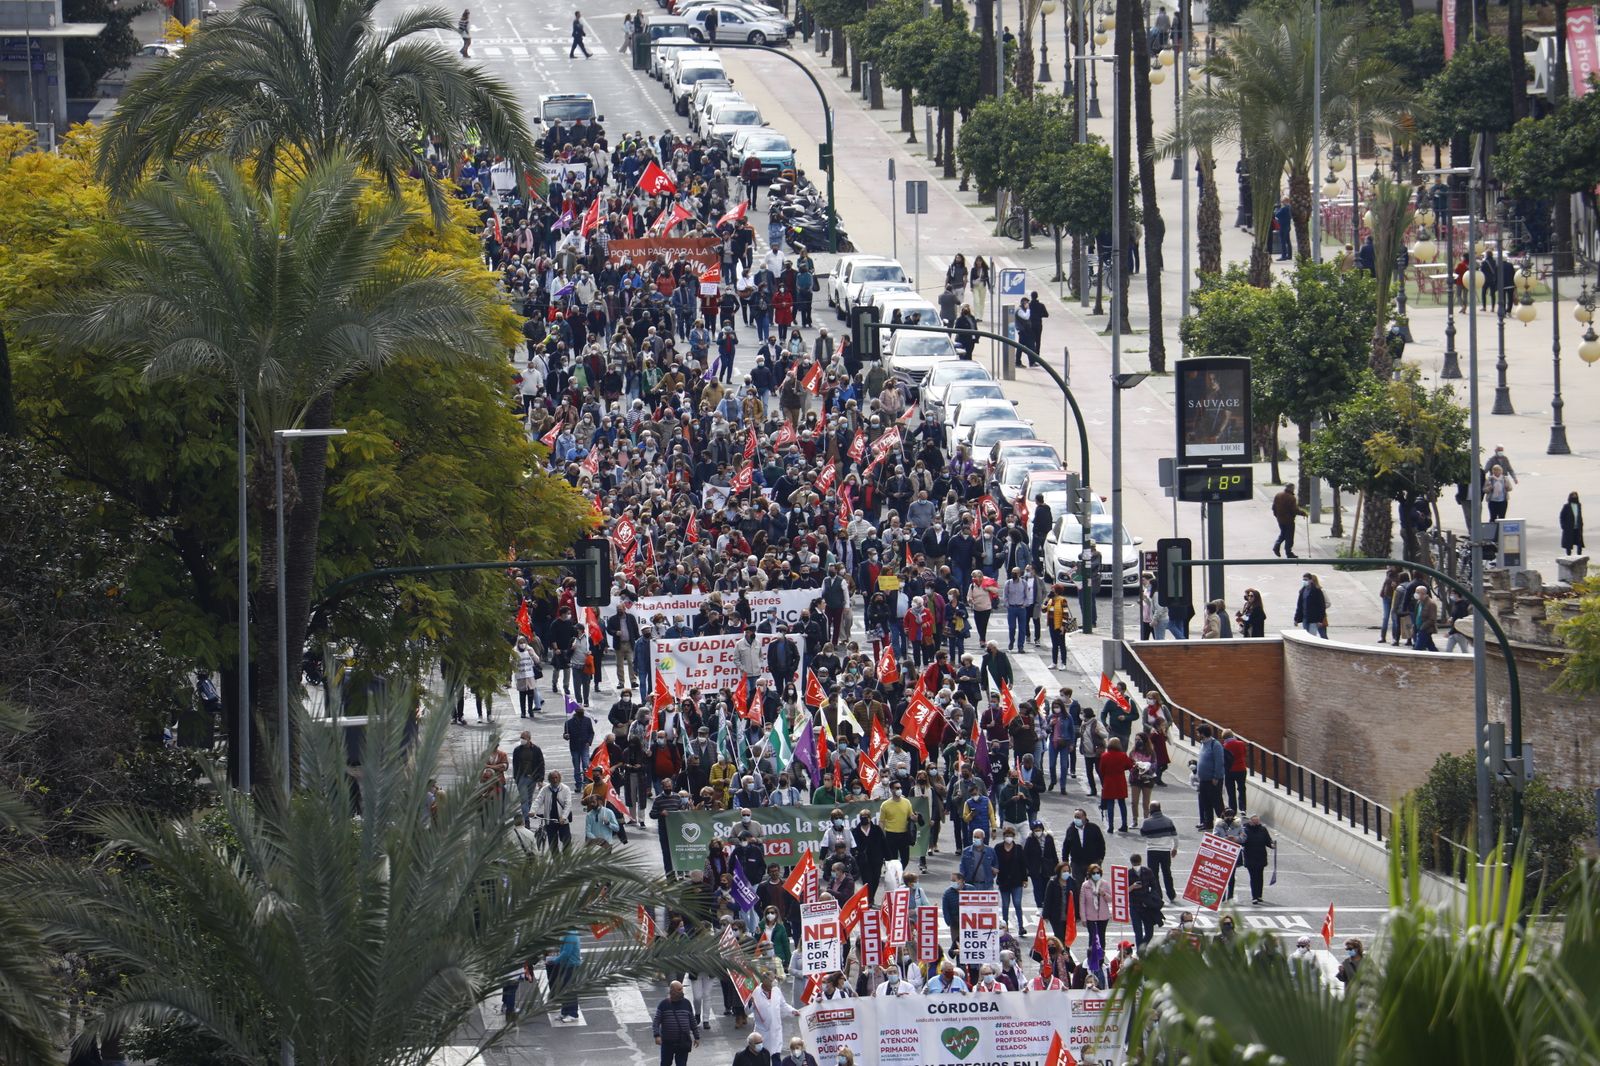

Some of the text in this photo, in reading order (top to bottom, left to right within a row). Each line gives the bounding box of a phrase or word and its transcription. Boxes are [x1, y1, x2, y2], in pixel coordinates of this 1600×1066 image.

[610, 249, 631, 258] POR
[633, 248, 646, 257] UN
[696, 247, 708, 256] LA
[1188, 399, 1240, 409] SAUVAGE
[1220, 444, 1240, 452] DIOR
[1207, 476, 1241, 490] 18°
[635, 600, 702, 611] #LaAndaluc
[748, 596, 781, 606] uieres
[657, 639, 740, 653] EL GUADIA
[697, 653, 714, 664] La
[686, 667, 707, 678] Las
[795, 818, 813, 833] la
[1201, 836, 1240, 855] CCOO
[806, 869, 817, 904] CCO
[960, 894, 997, 904] CCOO
[1114, 868, 1127, 920] CCOO
[810, 904, 831, 912] CCOO
[893, 893, 907, 941] CCOO
[961, 913, 997, 930] NO
[803, 922, 838, 942] NO
[921, 909, 935, 960] CCOO
[964, 930, 979, 939] RE
[863, 911, 880, 966] CCOO
[807, 942, 821, 950] RE
[964, 940, 988, 949] COR
[807, 950, 829, 960] COR
[964, 951, 985, 960] TES
[807, 961, 828, 971] TES
[927, 1001, 1000, 1014] CÓRDOBA
[819, 1011, 845, 1020] CCOO
[995, 1020, 1051, 1028] #RECUPEREMOS
[816, 1032, 858, 1044] #SANIDAD
[995, 1035, 1050, 1043] PROFESIONALES
[1070, 1034, 1111, 1044] PÚBLICA
